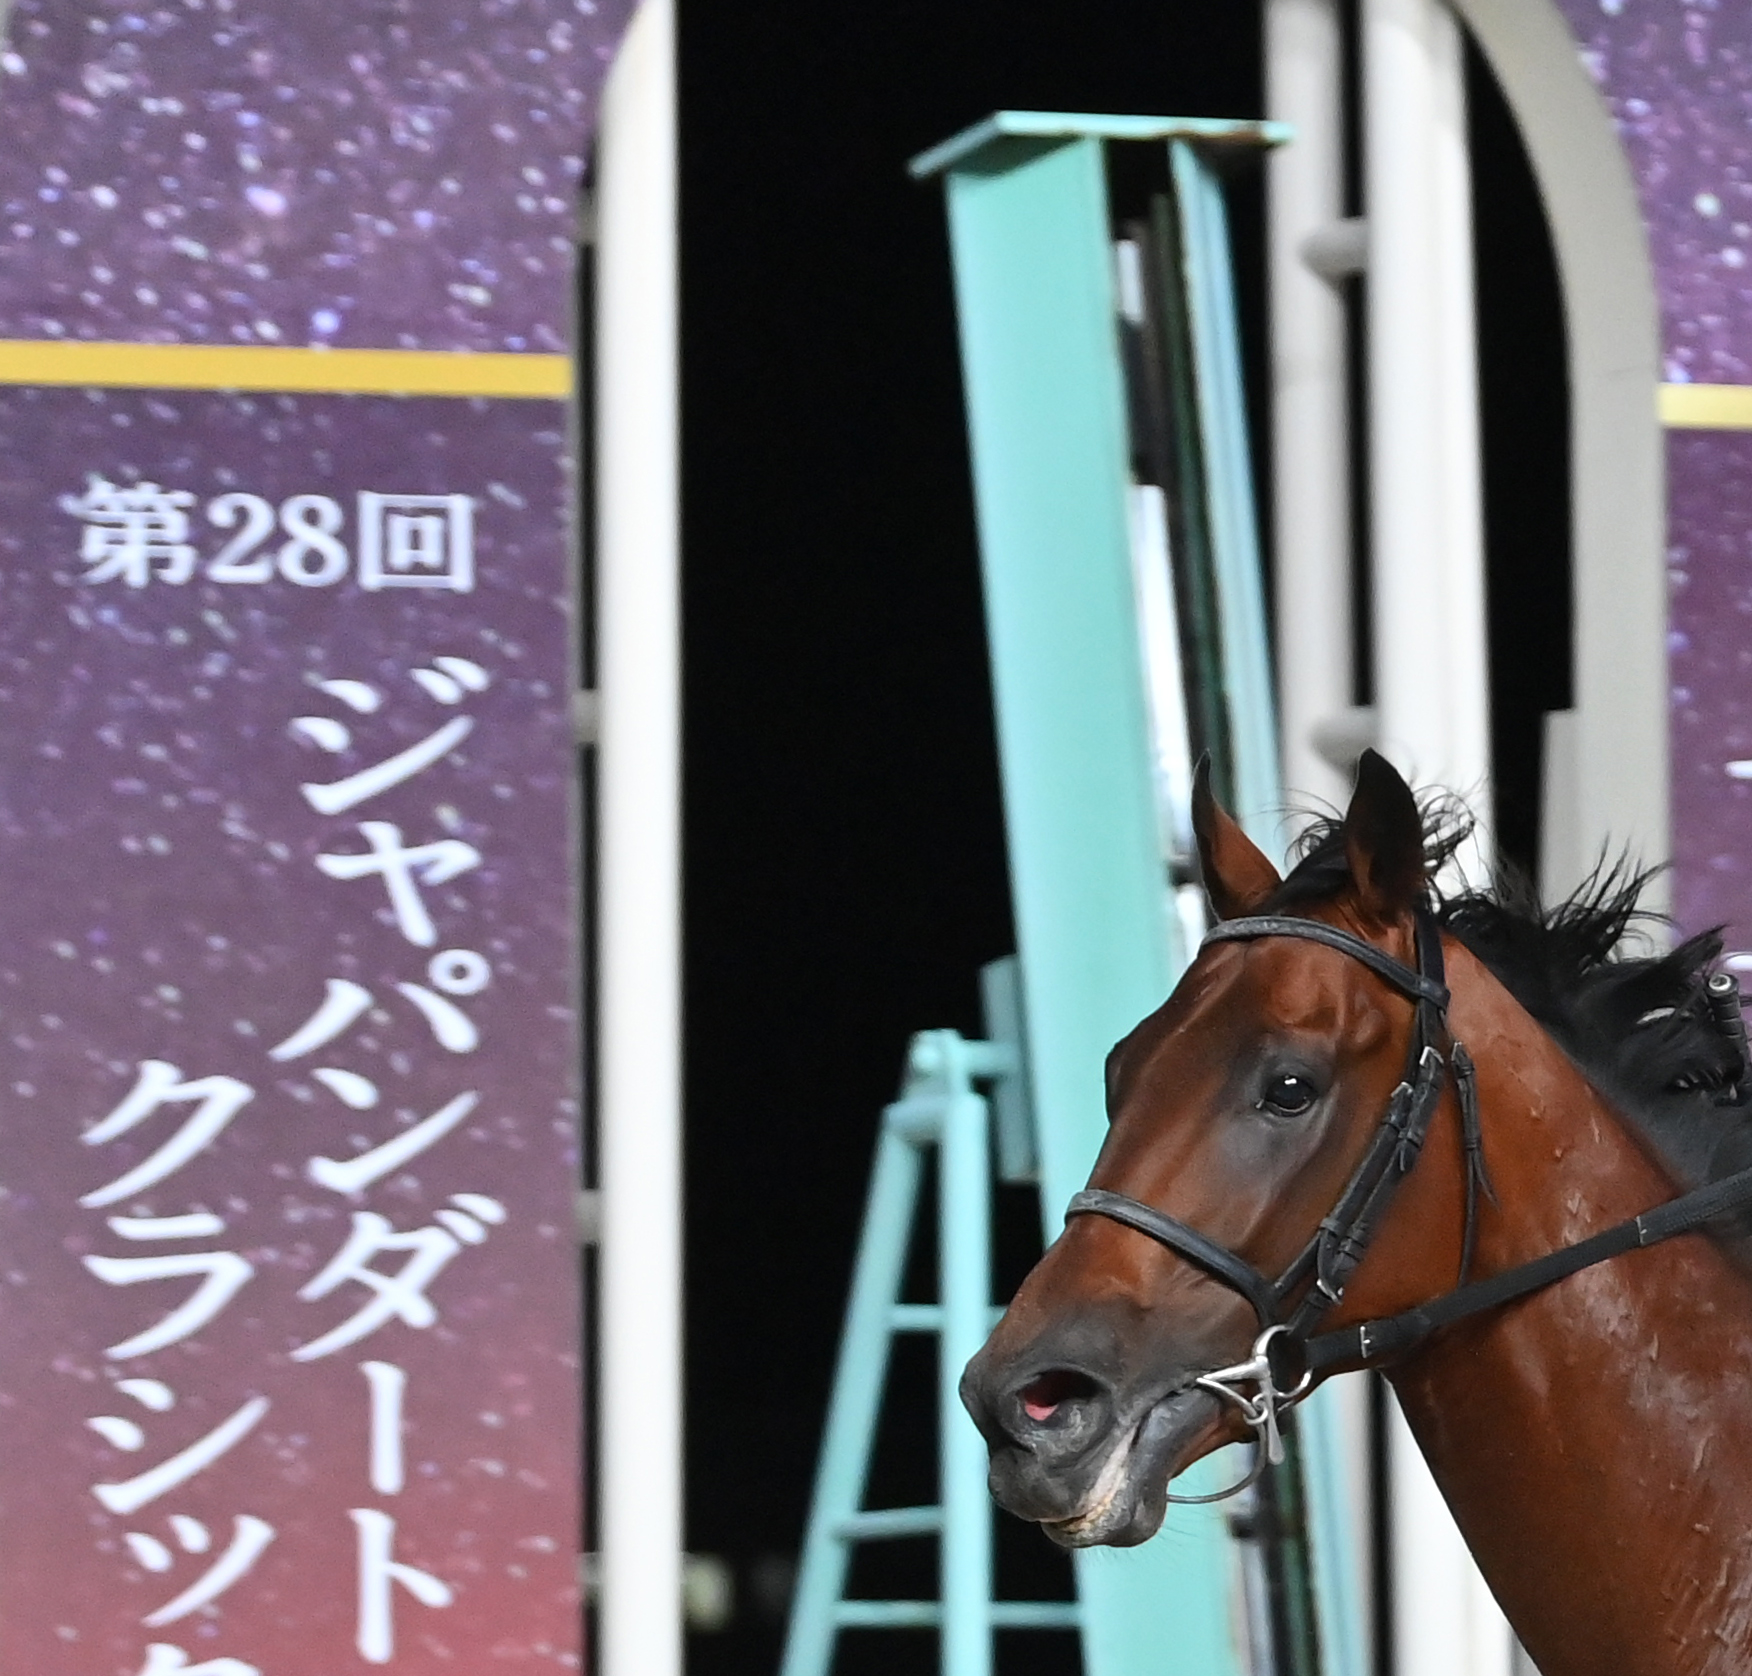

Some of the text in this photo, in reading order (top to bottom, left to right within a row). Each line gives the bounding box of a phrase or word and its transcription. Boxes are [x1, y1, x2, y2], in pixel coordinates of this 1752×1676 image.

[73, 477, 476, 592] 第28回
[268, 655, 506, 1664] ジャパンダート
